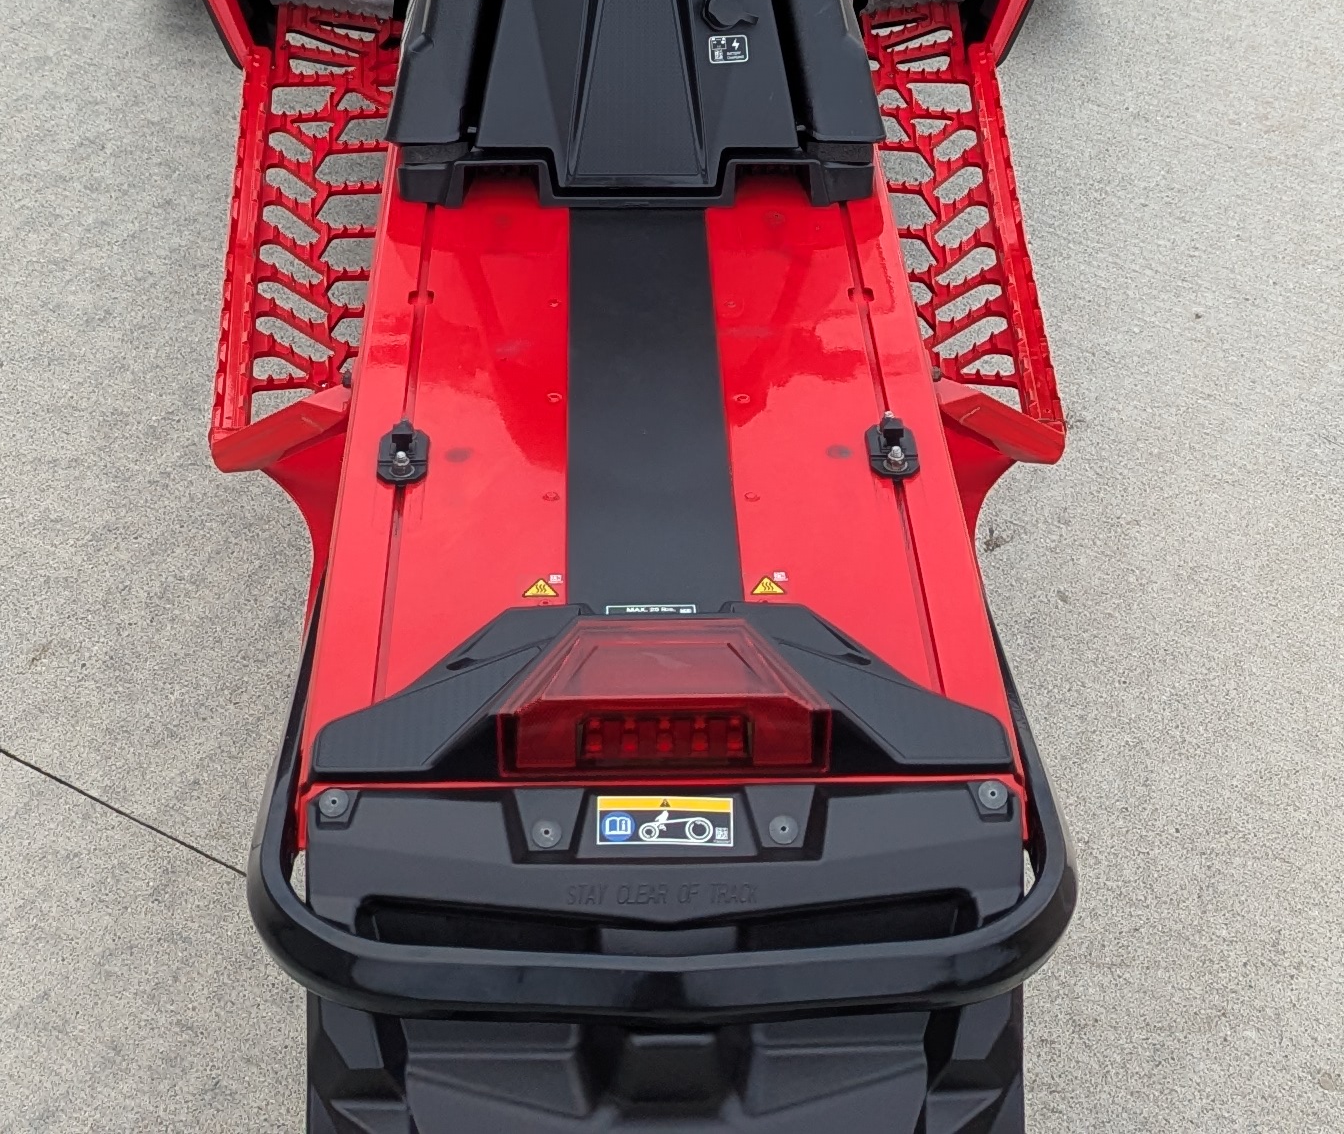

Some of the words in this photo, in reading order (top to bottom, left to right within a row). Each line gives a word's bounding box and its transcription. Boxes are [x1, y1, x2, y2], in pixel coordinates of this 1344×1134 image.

[566, 882, 609, 906] STAY
[616, 882, 670, 905] CLEAR
[677, 882, 701, 905] OF
[709, 882, 759, 905] TRACK
